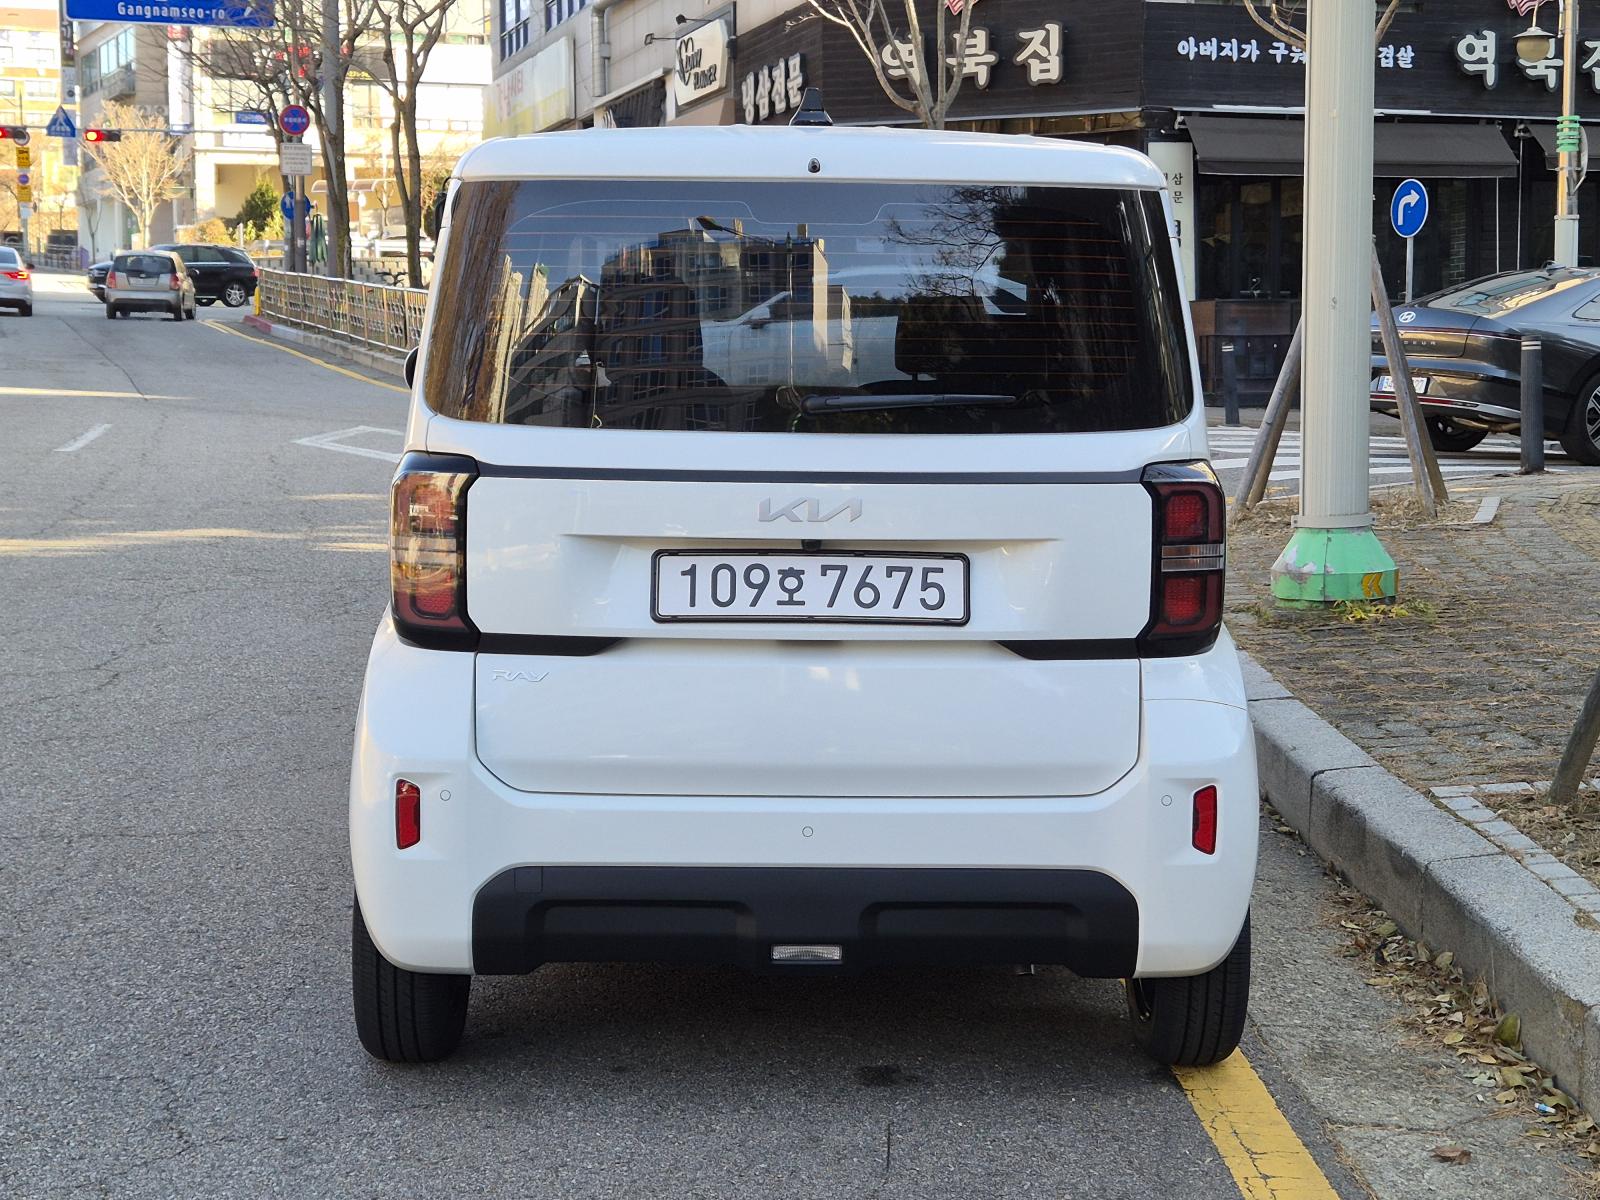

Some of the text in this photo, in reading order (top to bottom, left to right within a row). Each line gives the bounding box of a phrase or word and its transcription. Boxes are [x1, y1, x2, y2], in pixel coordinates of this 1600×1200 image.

[117, 3, 225, 20] Gangnamseo-ro
[1177, 36, 1261, 63] 아버지가
[1377, 44, 1416, 69] 겹살
[741, 51, 803, 125] 냉삼전문
[1172, 190, 1184, 204] 문
[757, 496, 863, 523] KIA
[680, 563, 946, 611] 109호 7675
